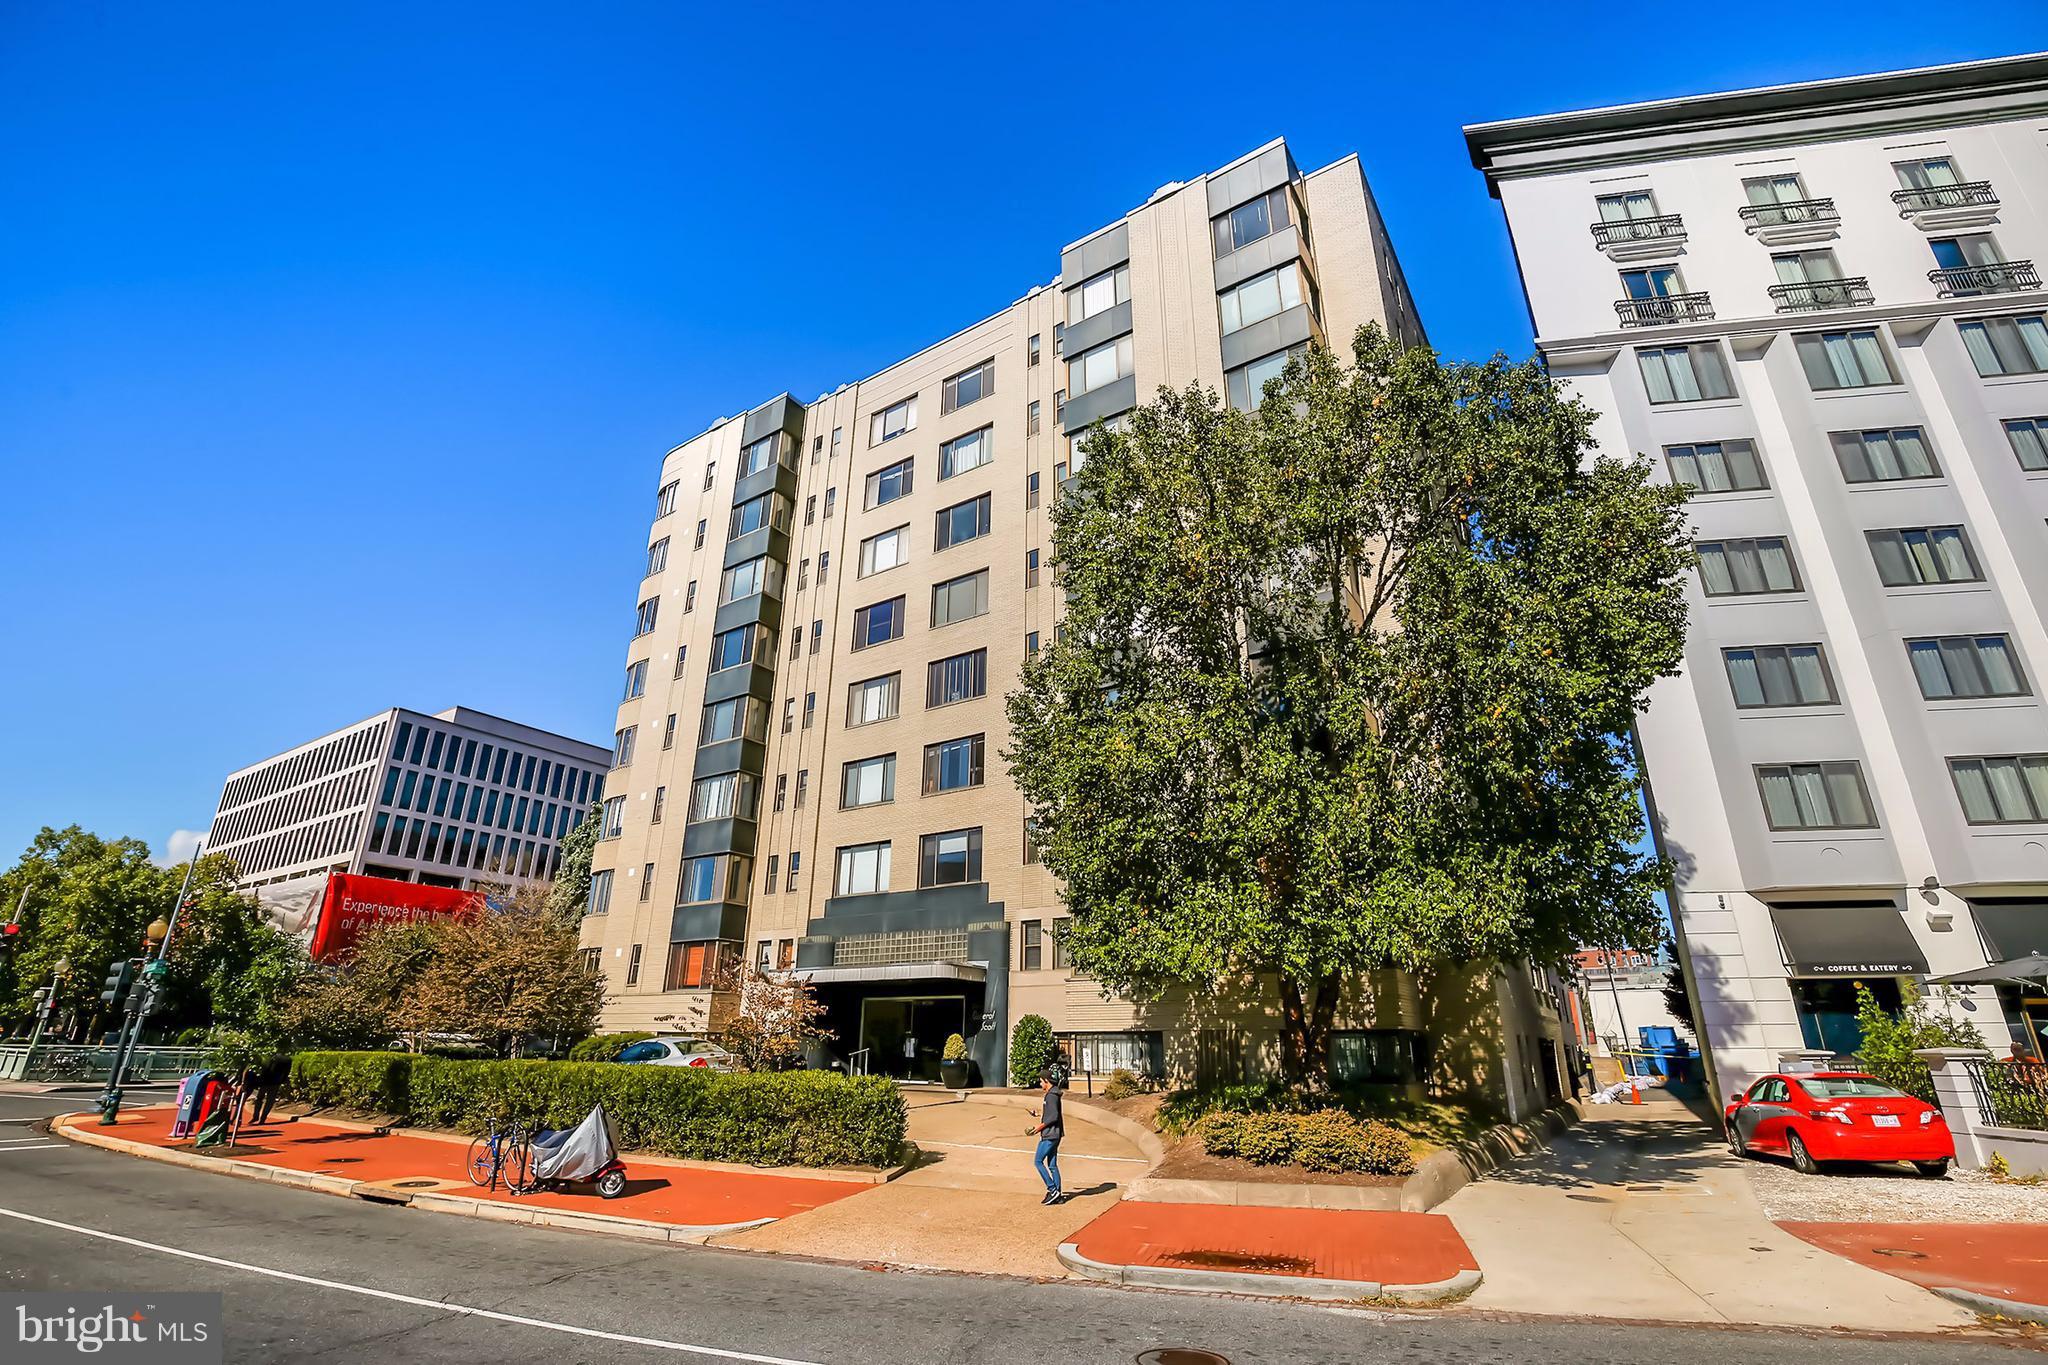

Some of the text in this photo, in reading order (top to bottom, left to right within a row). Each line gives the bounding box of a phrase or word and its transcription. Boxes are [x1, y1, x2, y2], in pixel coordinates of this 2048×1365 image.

[342, 897, 409, 918] Experience
[411, 906, 430, 921] the
[341, 917, 355, 930] of
